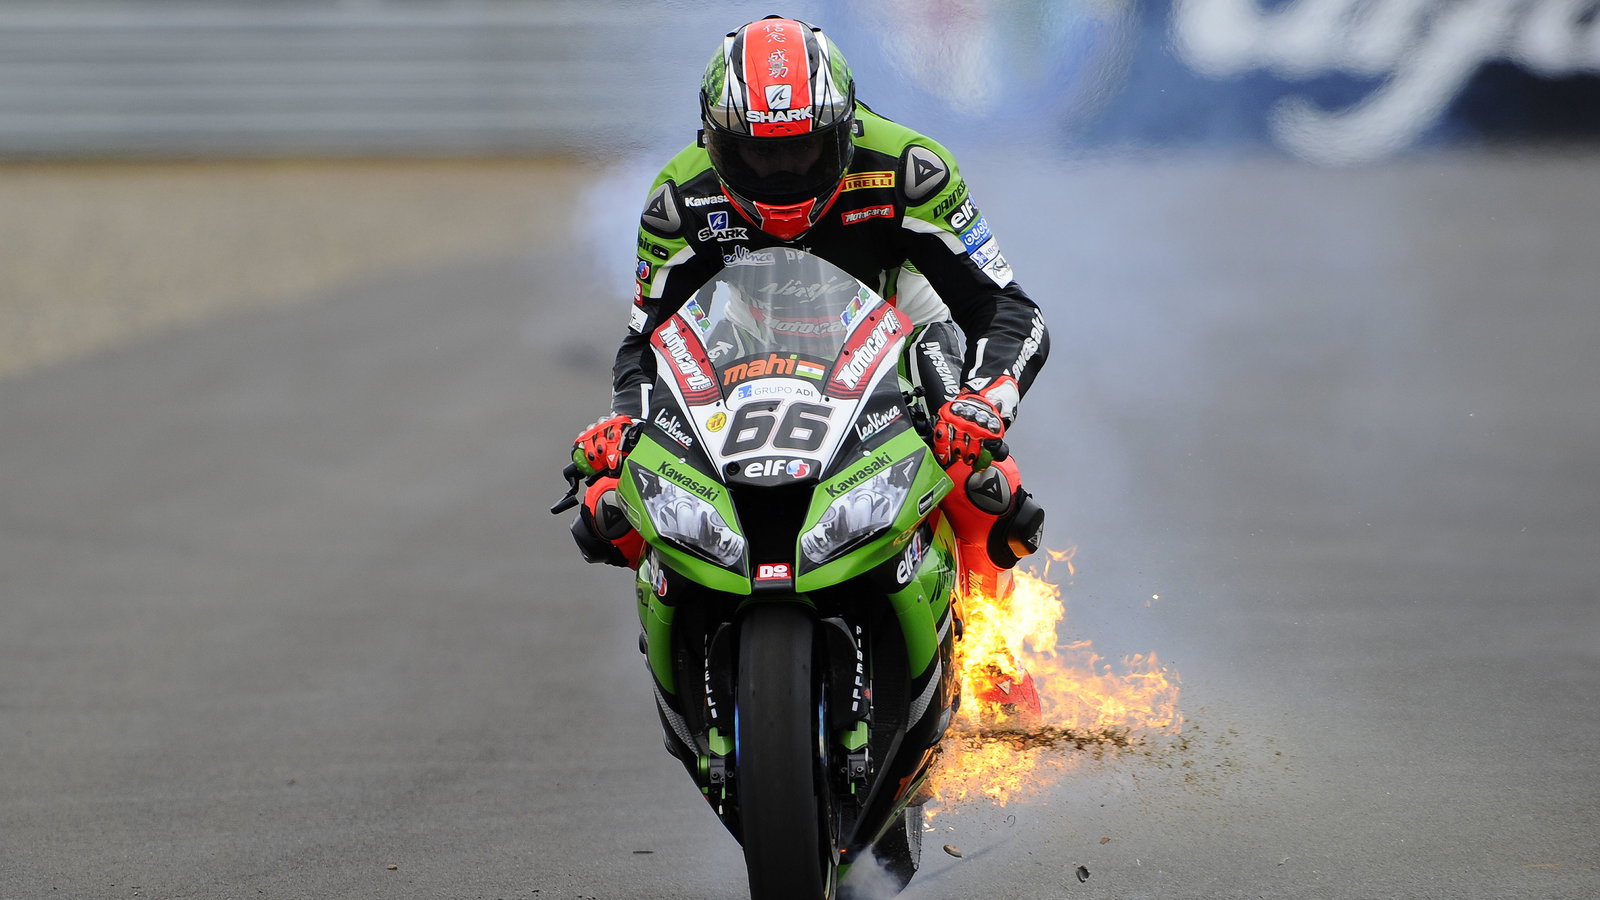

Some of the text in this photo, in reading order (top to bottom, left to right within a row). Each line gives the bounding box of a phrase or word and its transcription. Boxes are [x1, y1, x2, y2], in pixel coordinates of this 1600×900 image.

[746, 106, 814, 123] SHARK
[843, 179, 892, 190] IRELLI
[950, 199, 974, 229] elf
[1010, 308, 1045, 383] awasaki
[723, 353, 797, 386] mahi
[754, 386, 792, 396] GRUPO
[795, 388, 814, 397] ADI
[720, 399, 834, 457] 66
[855, 405, 901, 441] LeoVince
[657, 461, 720, 502] Kawasaki
[744, 459, 786, 478] elf
[825, 452, 893, 497] Kawasaki
[896, 543, 914, 584] elf
